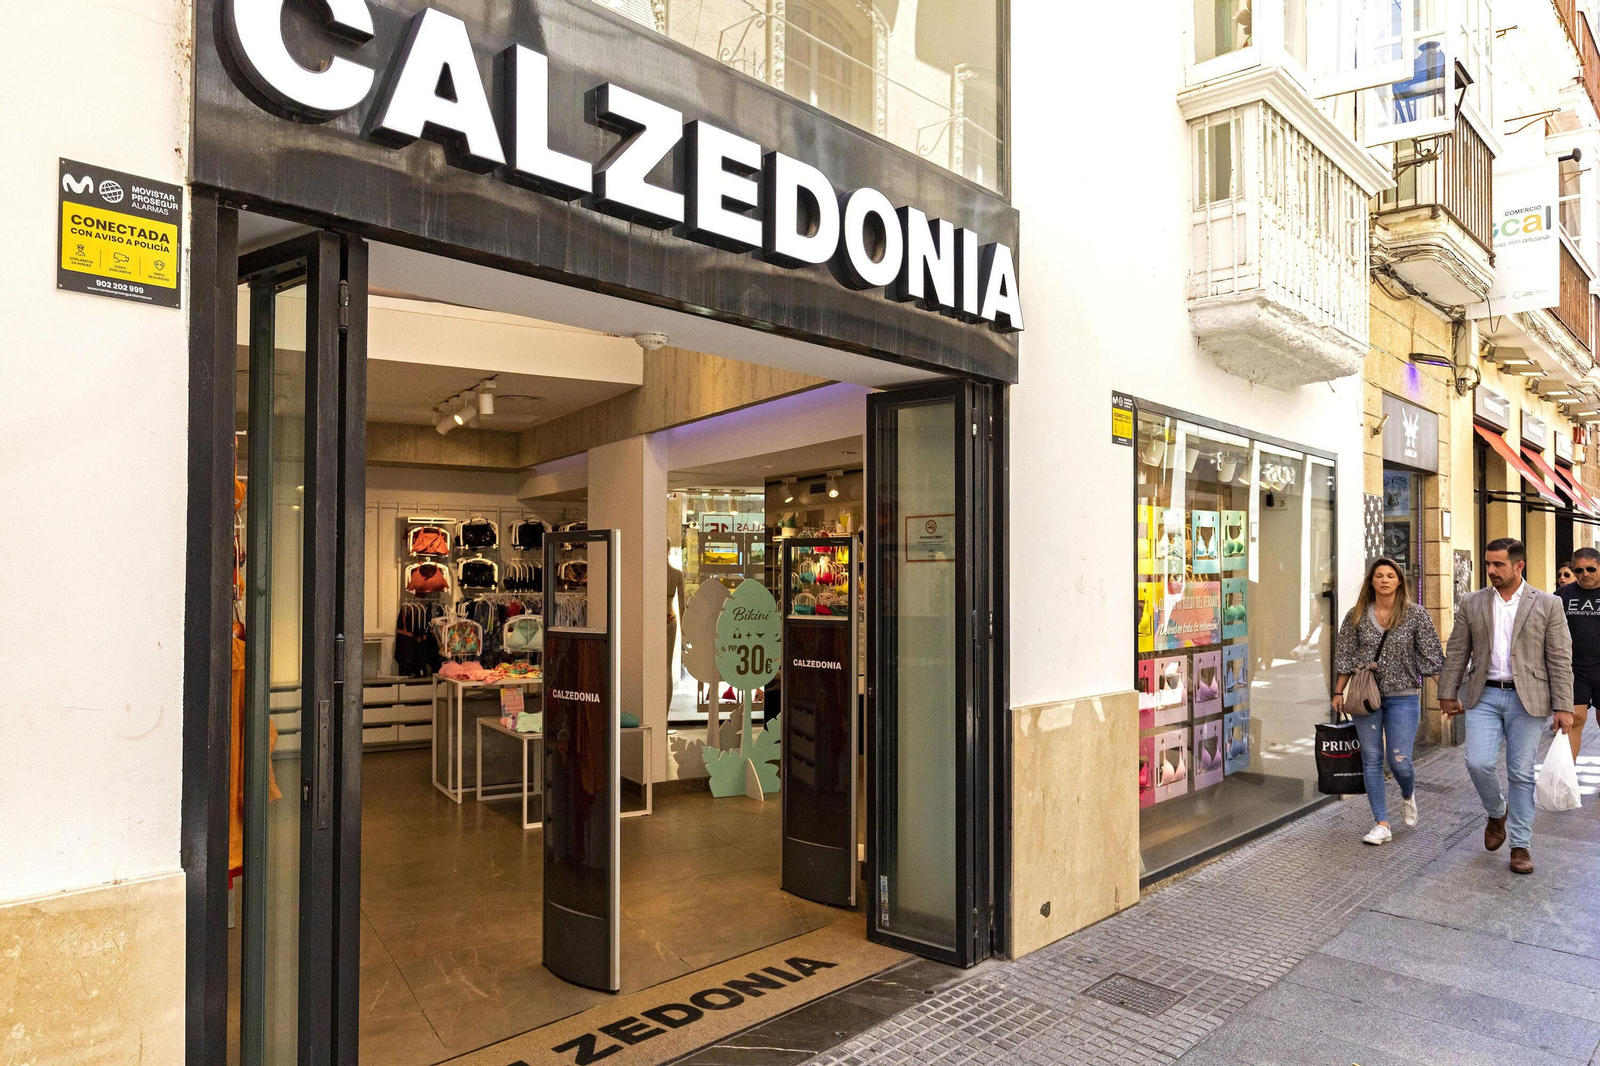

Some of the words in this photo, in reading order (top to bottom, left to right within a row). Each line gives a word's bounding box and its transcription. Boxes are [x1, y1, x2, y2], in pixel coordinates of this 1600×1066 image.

[233, 0, 1023, 331] CALZEDONIA
[131, 186, 175, 202] MOVISTAR
[131, 193, 179, 210] PROSEGUR
[131, 202, 169, 216] ALARMAS
[1504, 205, 1542, 217] COMERCIO
[70, 214, 170, 244] CONECTADA
[70, 227, 93, 238] CON
[94, 232, 124, 244] AVISO
[134, 240, 170, 253] POLICÍA
[96, 279, 112, 289] 902
[112, 282, 128, 292] 202
[129, 284, 144, 294] 999
[732, 606, 771, 621] Bikini
[792, 658, 842, 670] CALZEDONIA
[552, 689, 600, 703] CALZEDONIA
[507, 957, 839, 1066] ZEDONIA
